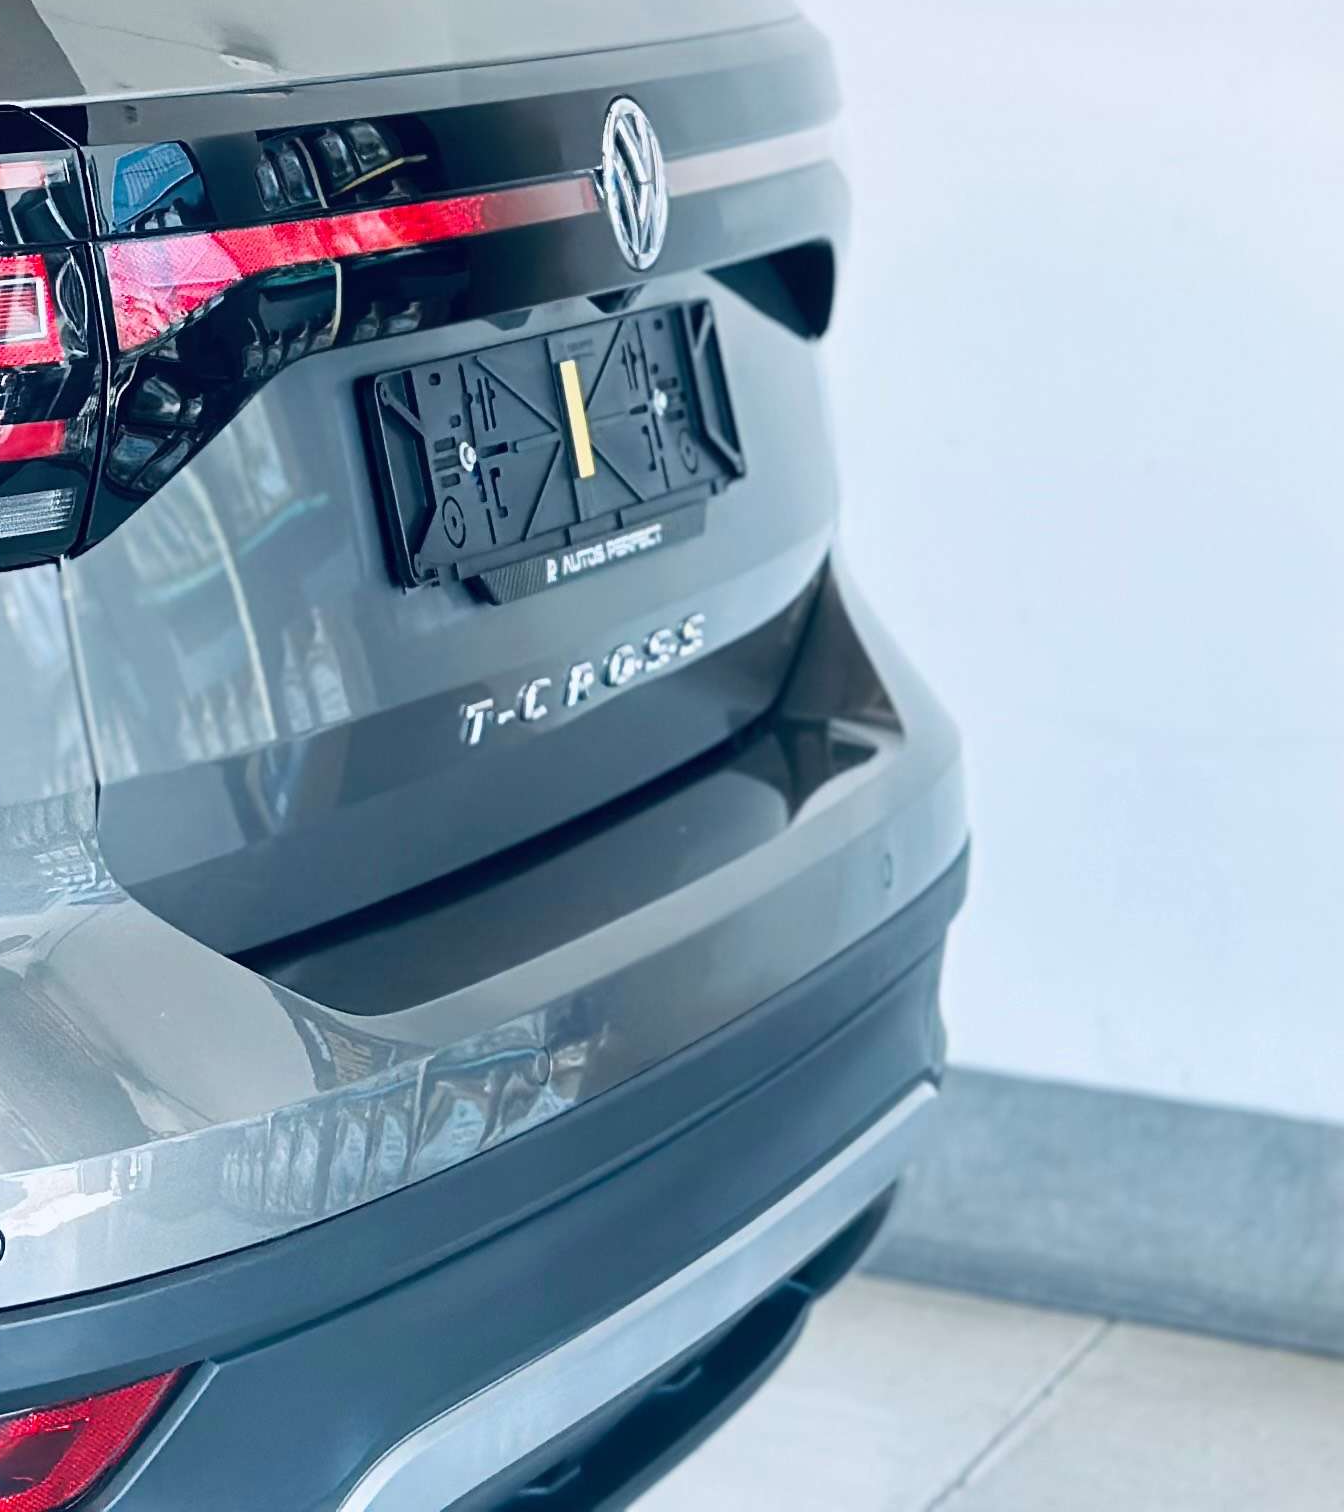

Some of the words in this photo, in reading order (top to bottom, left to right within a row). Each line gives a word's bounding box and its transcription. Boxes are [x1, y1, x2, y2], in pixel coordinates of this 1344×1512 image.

[563, 543, 606, 576] AUTOS
[606, 523, 662, 560] PERFECT
[461, 613, 705, 745] T-CROSS
